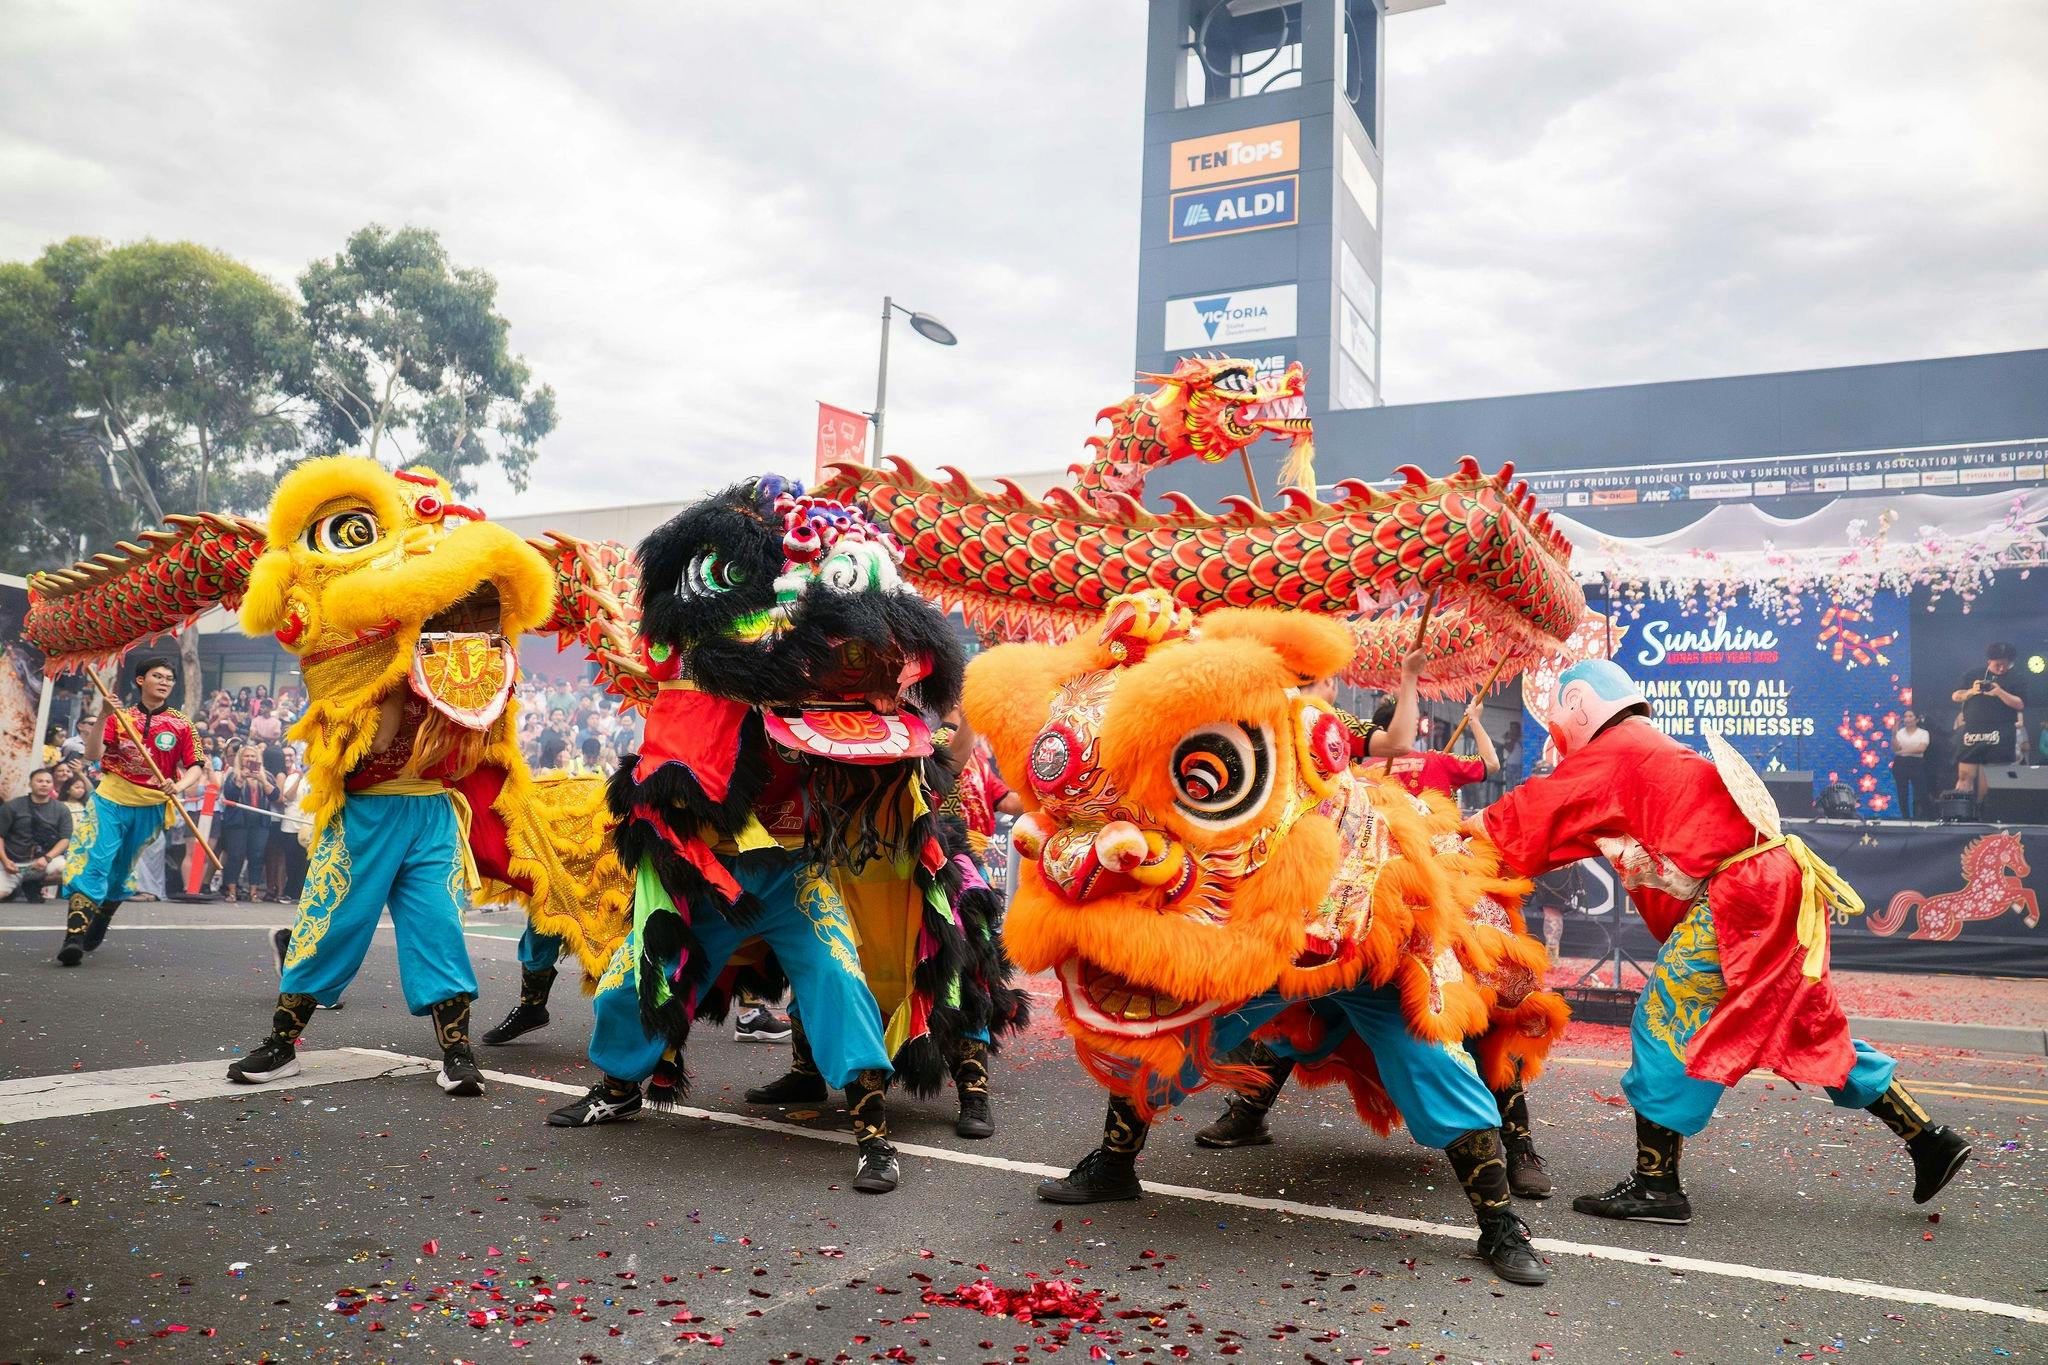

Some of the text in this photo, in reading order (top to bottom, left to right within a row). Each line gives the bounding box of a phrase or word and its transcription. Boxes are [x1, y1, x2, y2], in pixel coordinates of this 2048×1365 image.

[1214, 191, 1284, 222] ALDI
[1200, 306, 1268, 323] VICTORIA
[1533, 479, 1566, 490] EVENT
[1569, 478, 1580, 488] IS
[1584, 476, 1630, 488] PROUDLY
[1635, 473, 1684, 485] BROUGHT
[1688, 472, 1701, 482] TO
[1706, 470, 1727, 481] YOU
[1732, 469, 1746, 479] BY
[1750, 466, 1808, 478] SUNSHINE
[1812, 461, 1871, 474] BUSINESS
[1876, 456, 1957, 470] ASSOCIATION
[1963, 453, 1994, 464] WITH
[1641, 489, 1671, 502] ANZ
[1638, 611, 1778, 666] Sunshine
[1634, 679, 1789, 698] HANK YOU TO ALL
[1694, 698, 1788, 717] FABULOUS
[1653, 717, 1815, 736] HINE BUSINESSES
[1360, 812, 1375, 849] Carpent
